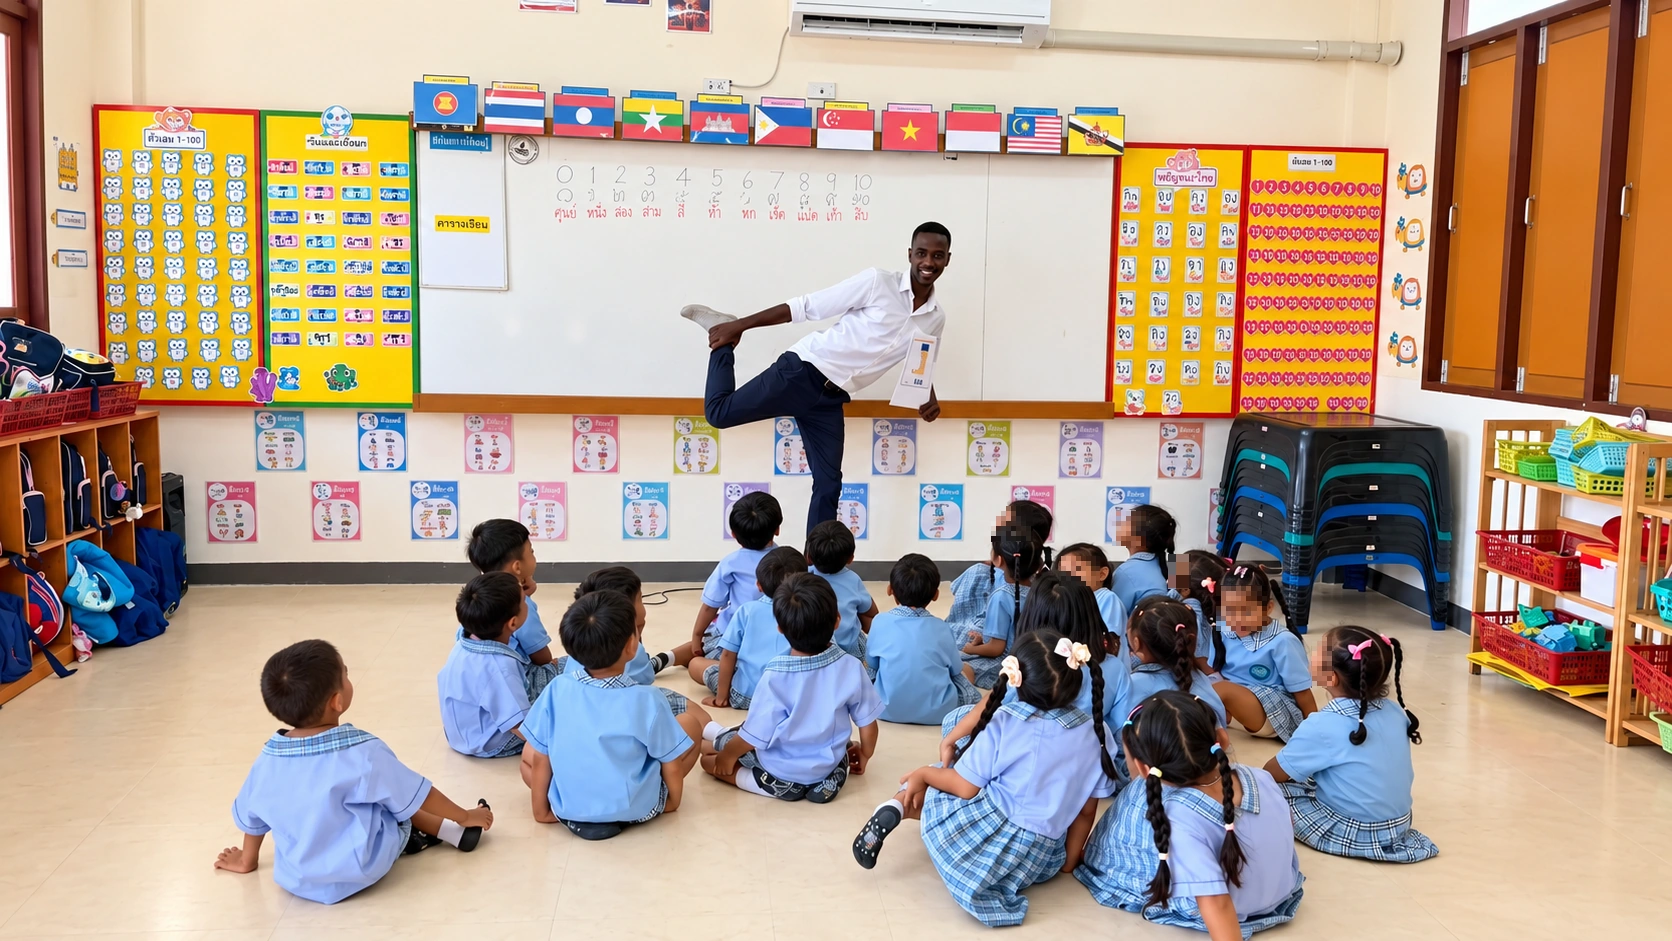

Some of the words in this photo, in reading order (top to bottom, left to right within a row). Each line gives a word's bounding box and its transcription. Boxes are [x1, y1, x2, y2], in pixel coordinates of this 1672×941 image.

[177, 136, 201, 144] 1-100
[1313, 158, 1333, 166] 1-100
[556, 164, 574, 184] 0
[590, 166, 595, 184] 1
[615, 165, 626, 184] 2
[643, 166, 656, 187] 3
[675, 167, 692, 187] 4
[711, 169, 723, 187] 5
[742, 170, 754, 190] 6
[770, 171, 785, 190] 7
[799, 172, 810, 192] 8
[826, 172, 837, 191] 9
[854, 173, 873, 191] 10
[1255, 182, 1260, 191] 1
[1268, 183, 1274, 191] 2
[1282, 183, 1287, 191] 3
[1321, 184, 1326, 192] 6
[1334, 184, 1340, 192] 7
[1347, 185, 1353, 193] 8
[1360, 185, 1365, 193] 9
